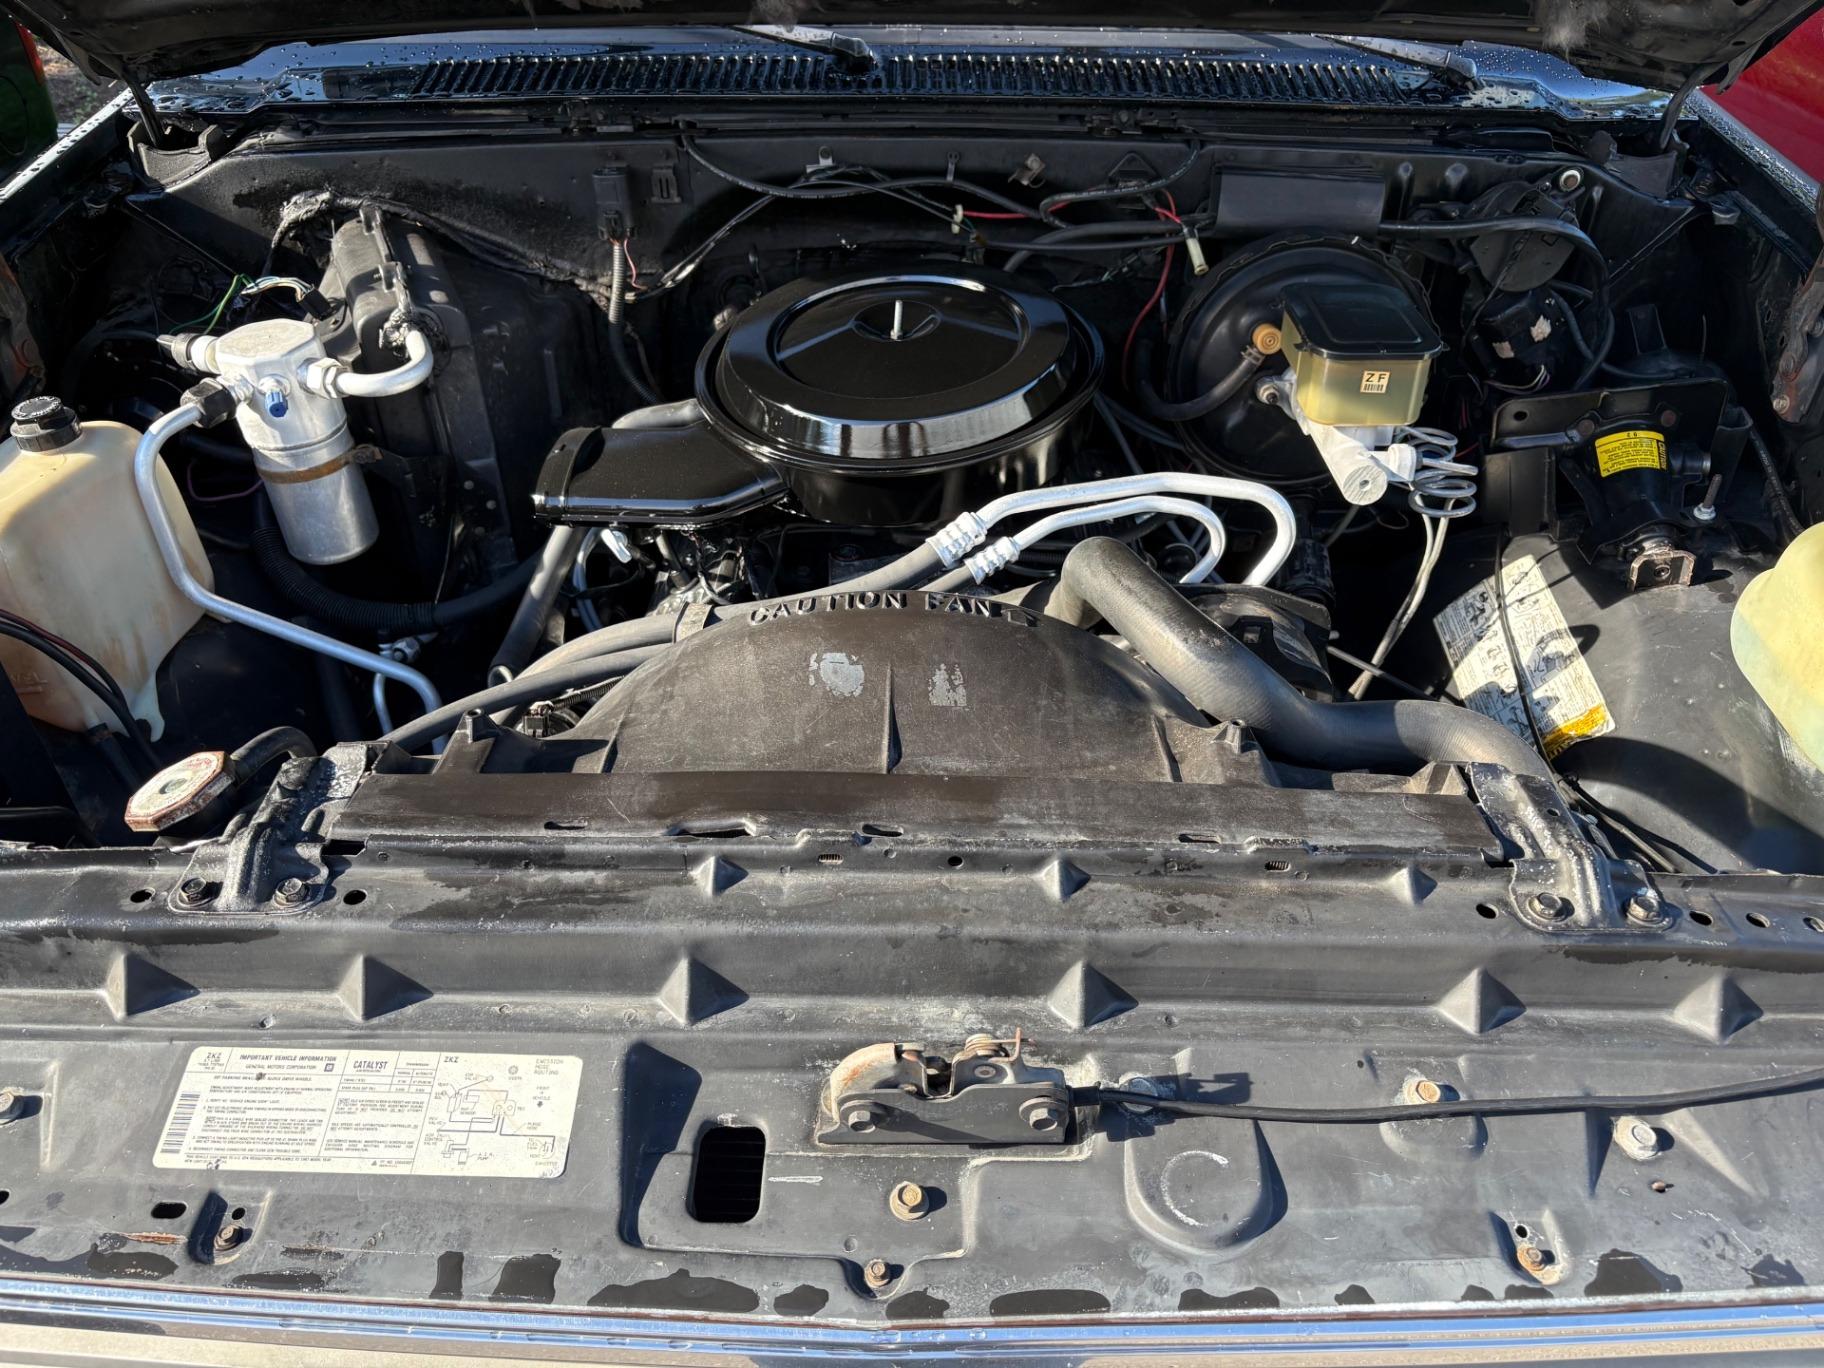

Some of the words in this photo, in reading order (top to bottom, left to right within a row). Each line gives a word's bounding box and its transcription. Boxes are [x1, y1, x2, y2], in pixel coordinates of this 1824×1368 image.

[1365, 372, 1387, 382] ZF
[749, 591, 907, 625] CAUTION
[924, 592, 1002, 618] FAN
[353, 1060, 388, 1070] CATALYST
